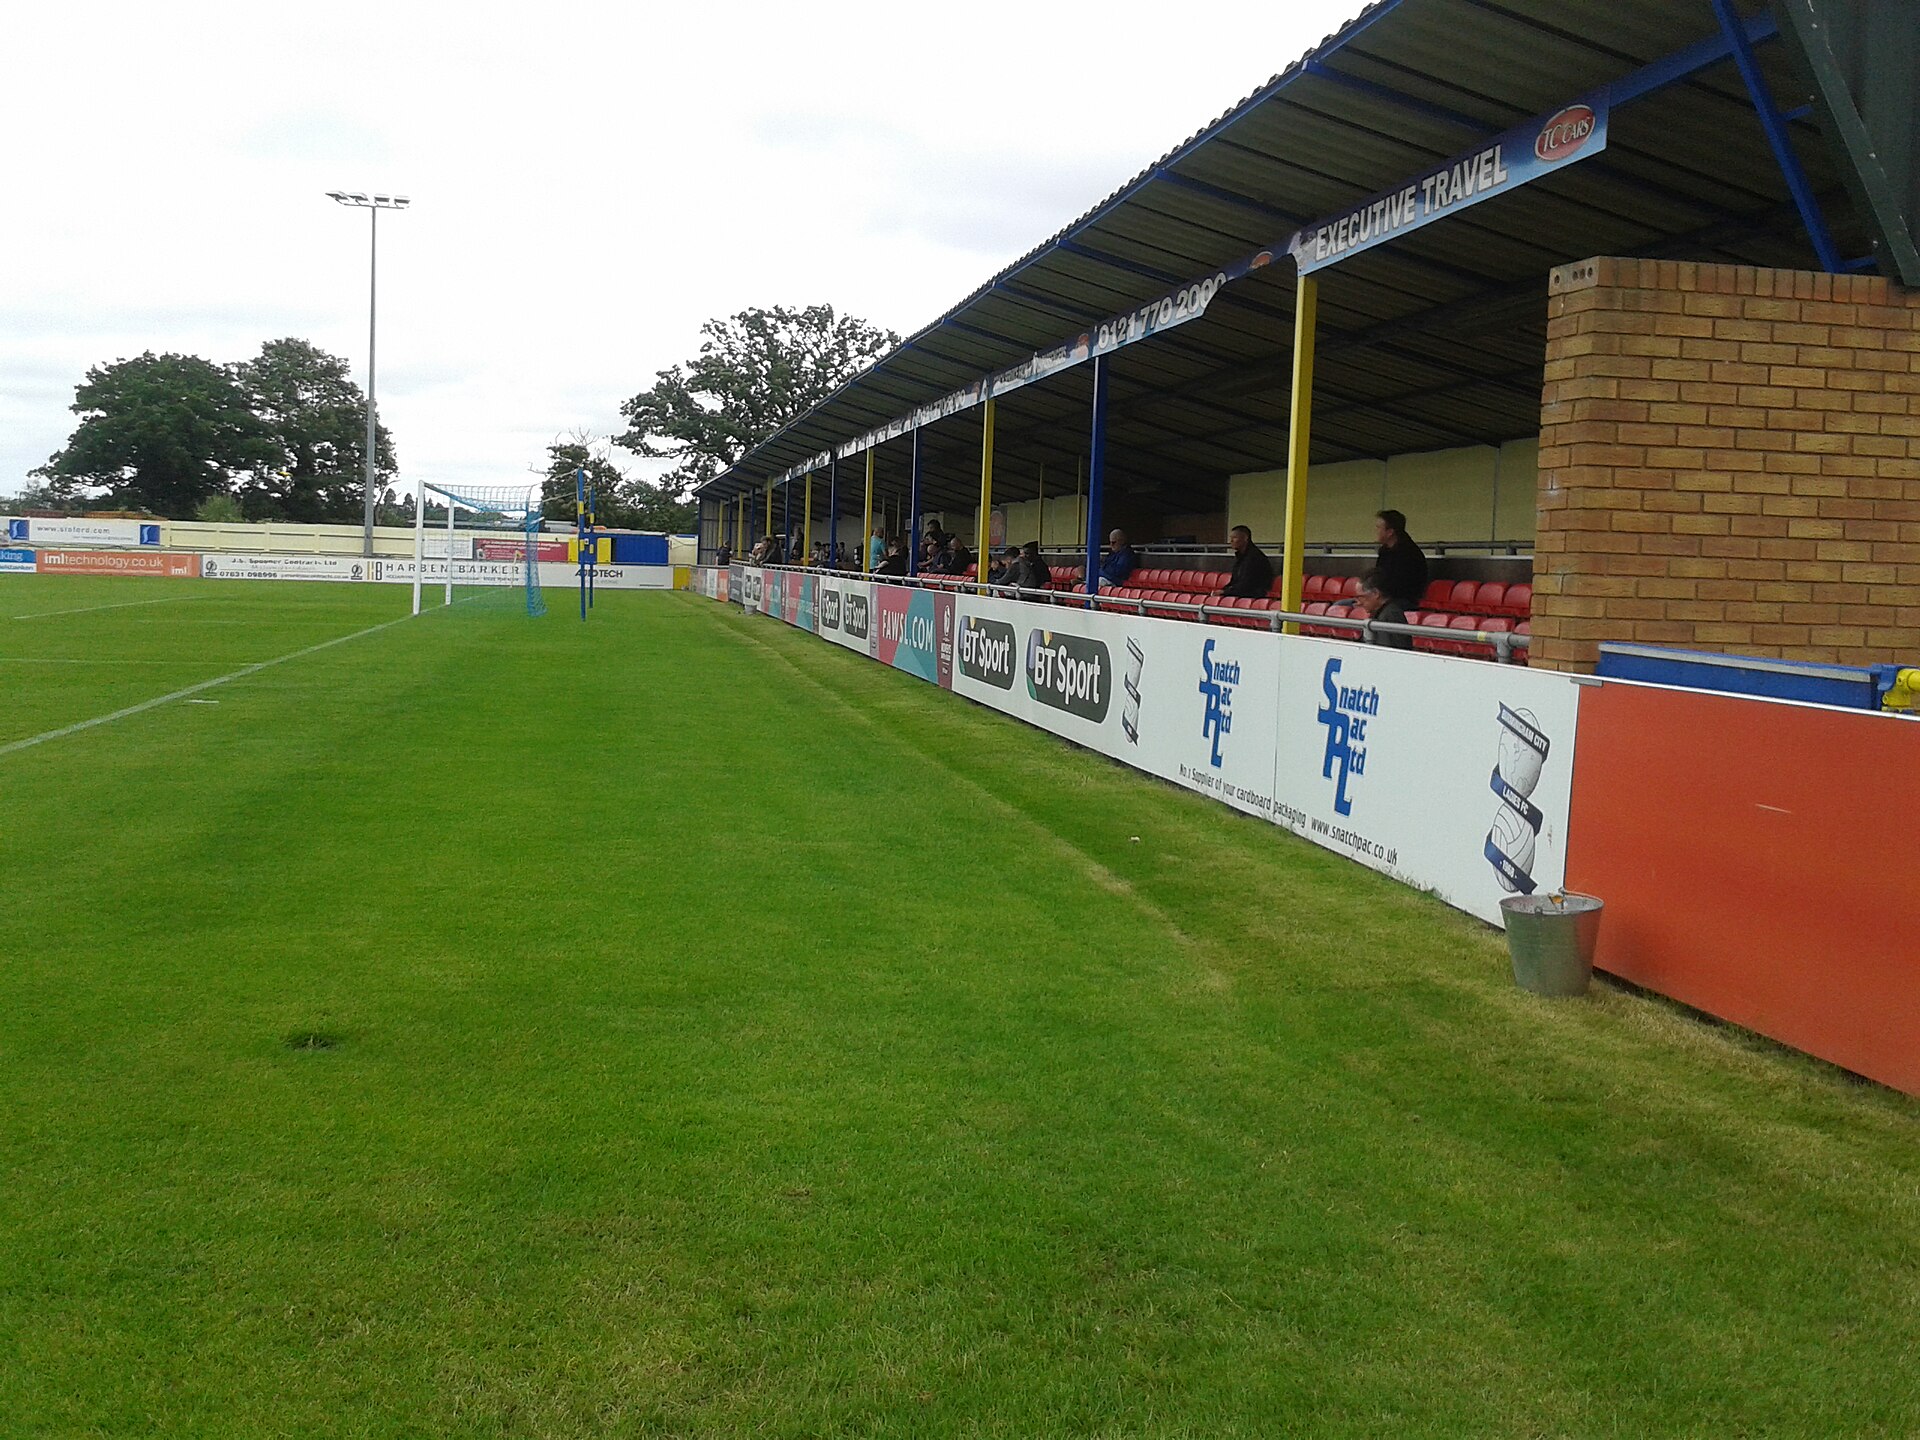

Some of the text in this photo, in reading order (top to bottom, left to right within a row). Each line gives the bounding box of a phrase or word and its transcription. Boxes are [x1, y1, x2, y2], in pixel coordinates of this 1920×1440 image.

[1543, 124, 1562, 152] TC
[1315, 144, 1508, 261] EXECUTIVE TRAVEL
[1098, 312, 1136, 349] 0121
[1140, 296, 1173, 334] 770
[44, 552, 164, 569] imltechnology.co.uk
[386, 562, 520, 575] HARBEN BARKER
[882, 608, 934, 653] FAWSL.COM
[963, 629, 979, 666] BT
[978, 627, 1010, 677] Sport
[1034, 645, 1056, 689] BT
[1056, 645, 1101, 705] Sport
[1199, 638, 1240, 693] Snatch
[1318, 657, 1380, 724] Snatch
[1192, 768, 1215, 788] Supplier
[1215, 778, 1222, 791] of
[1236, 788, 1272, 811] cardboard
[1273, 800, 1307, 828] packaging
[1311, 816, 1398, 866] www.snatchpac.co.uk
